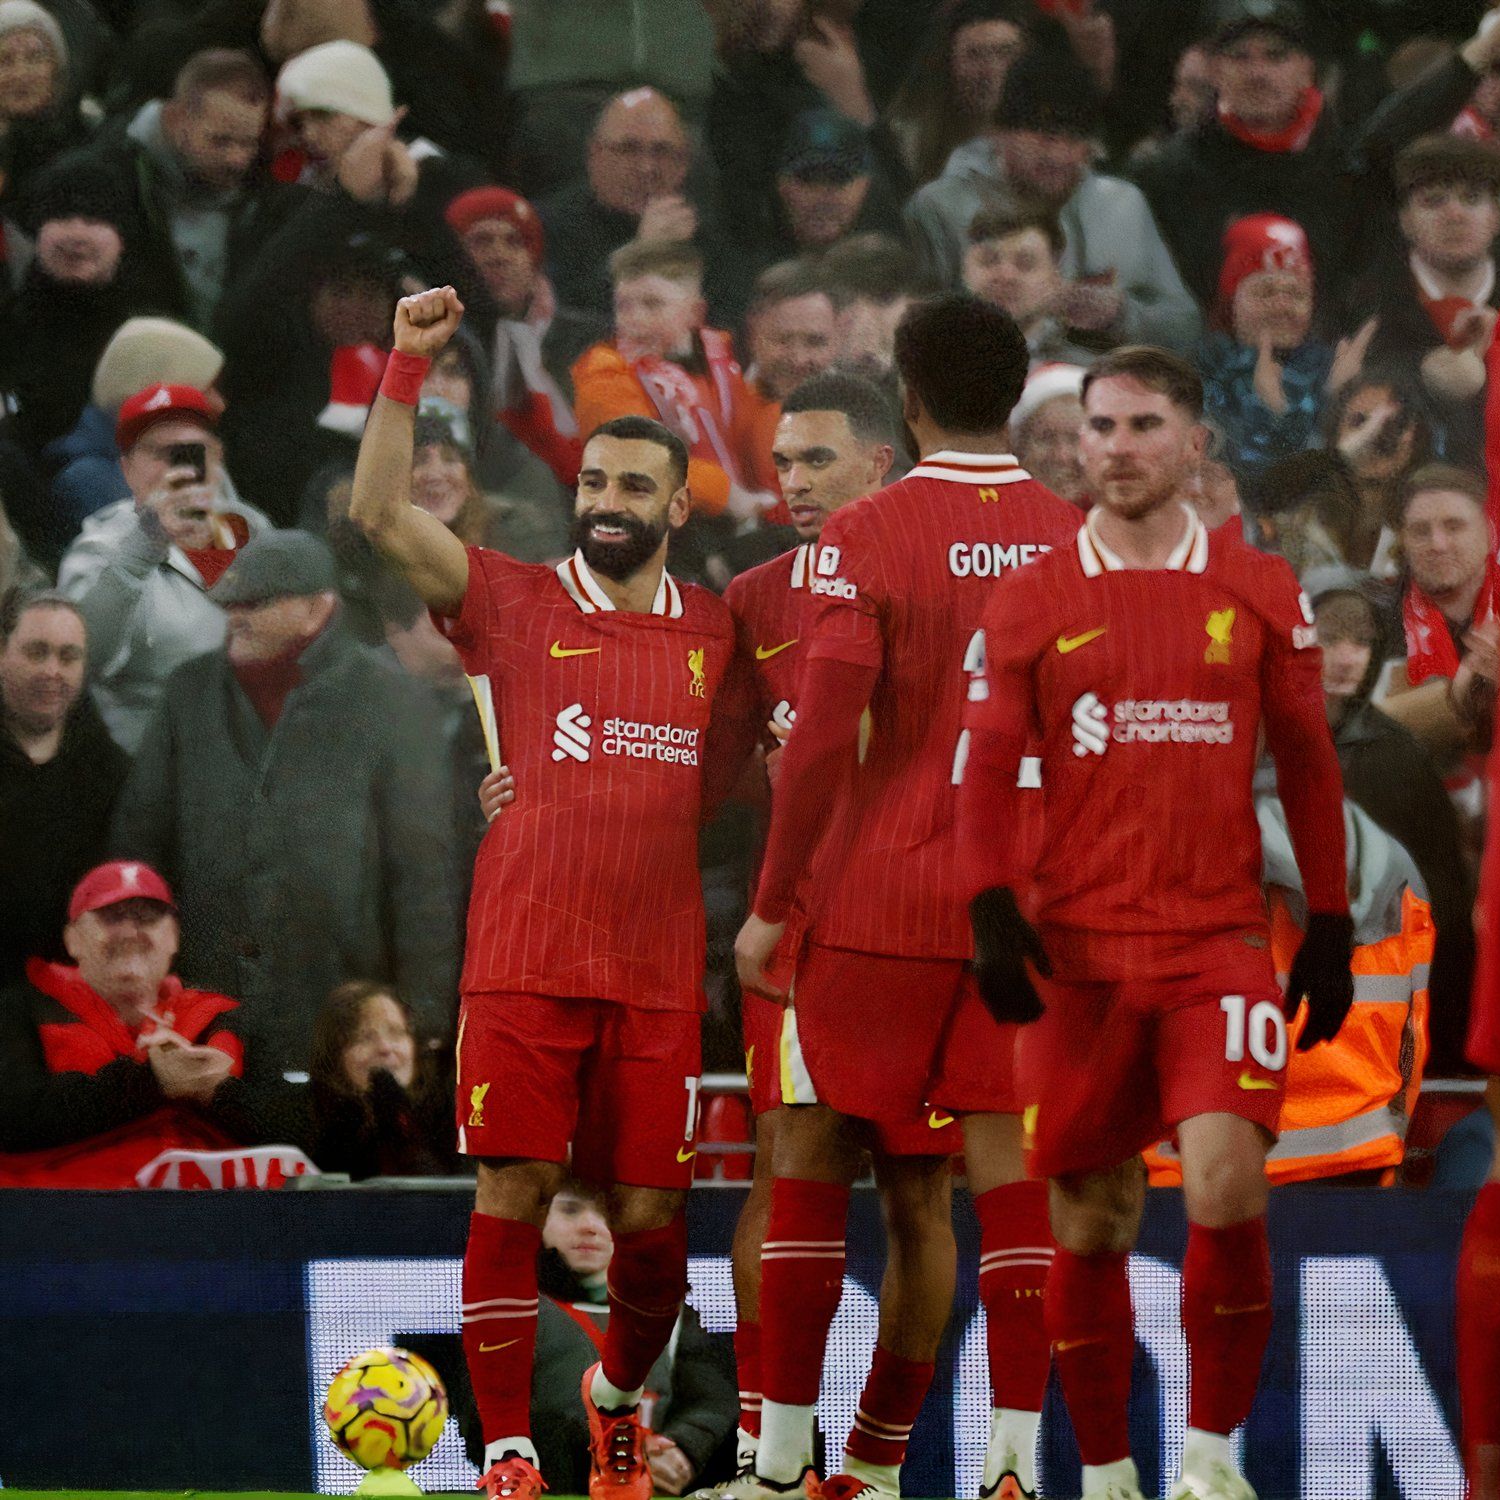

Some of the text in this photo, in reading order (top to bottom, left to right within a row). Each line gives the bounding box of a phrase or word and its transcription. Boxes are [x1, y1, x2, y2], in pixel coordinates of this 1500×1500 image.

[949, 542, 1054, 578] GOME
[602, 717, 700, 747] standard
[602, 736, 698, 766] chartered
[1219, 995, 1287, 1071] 10
[684, 1076, 701, 1141] 1
